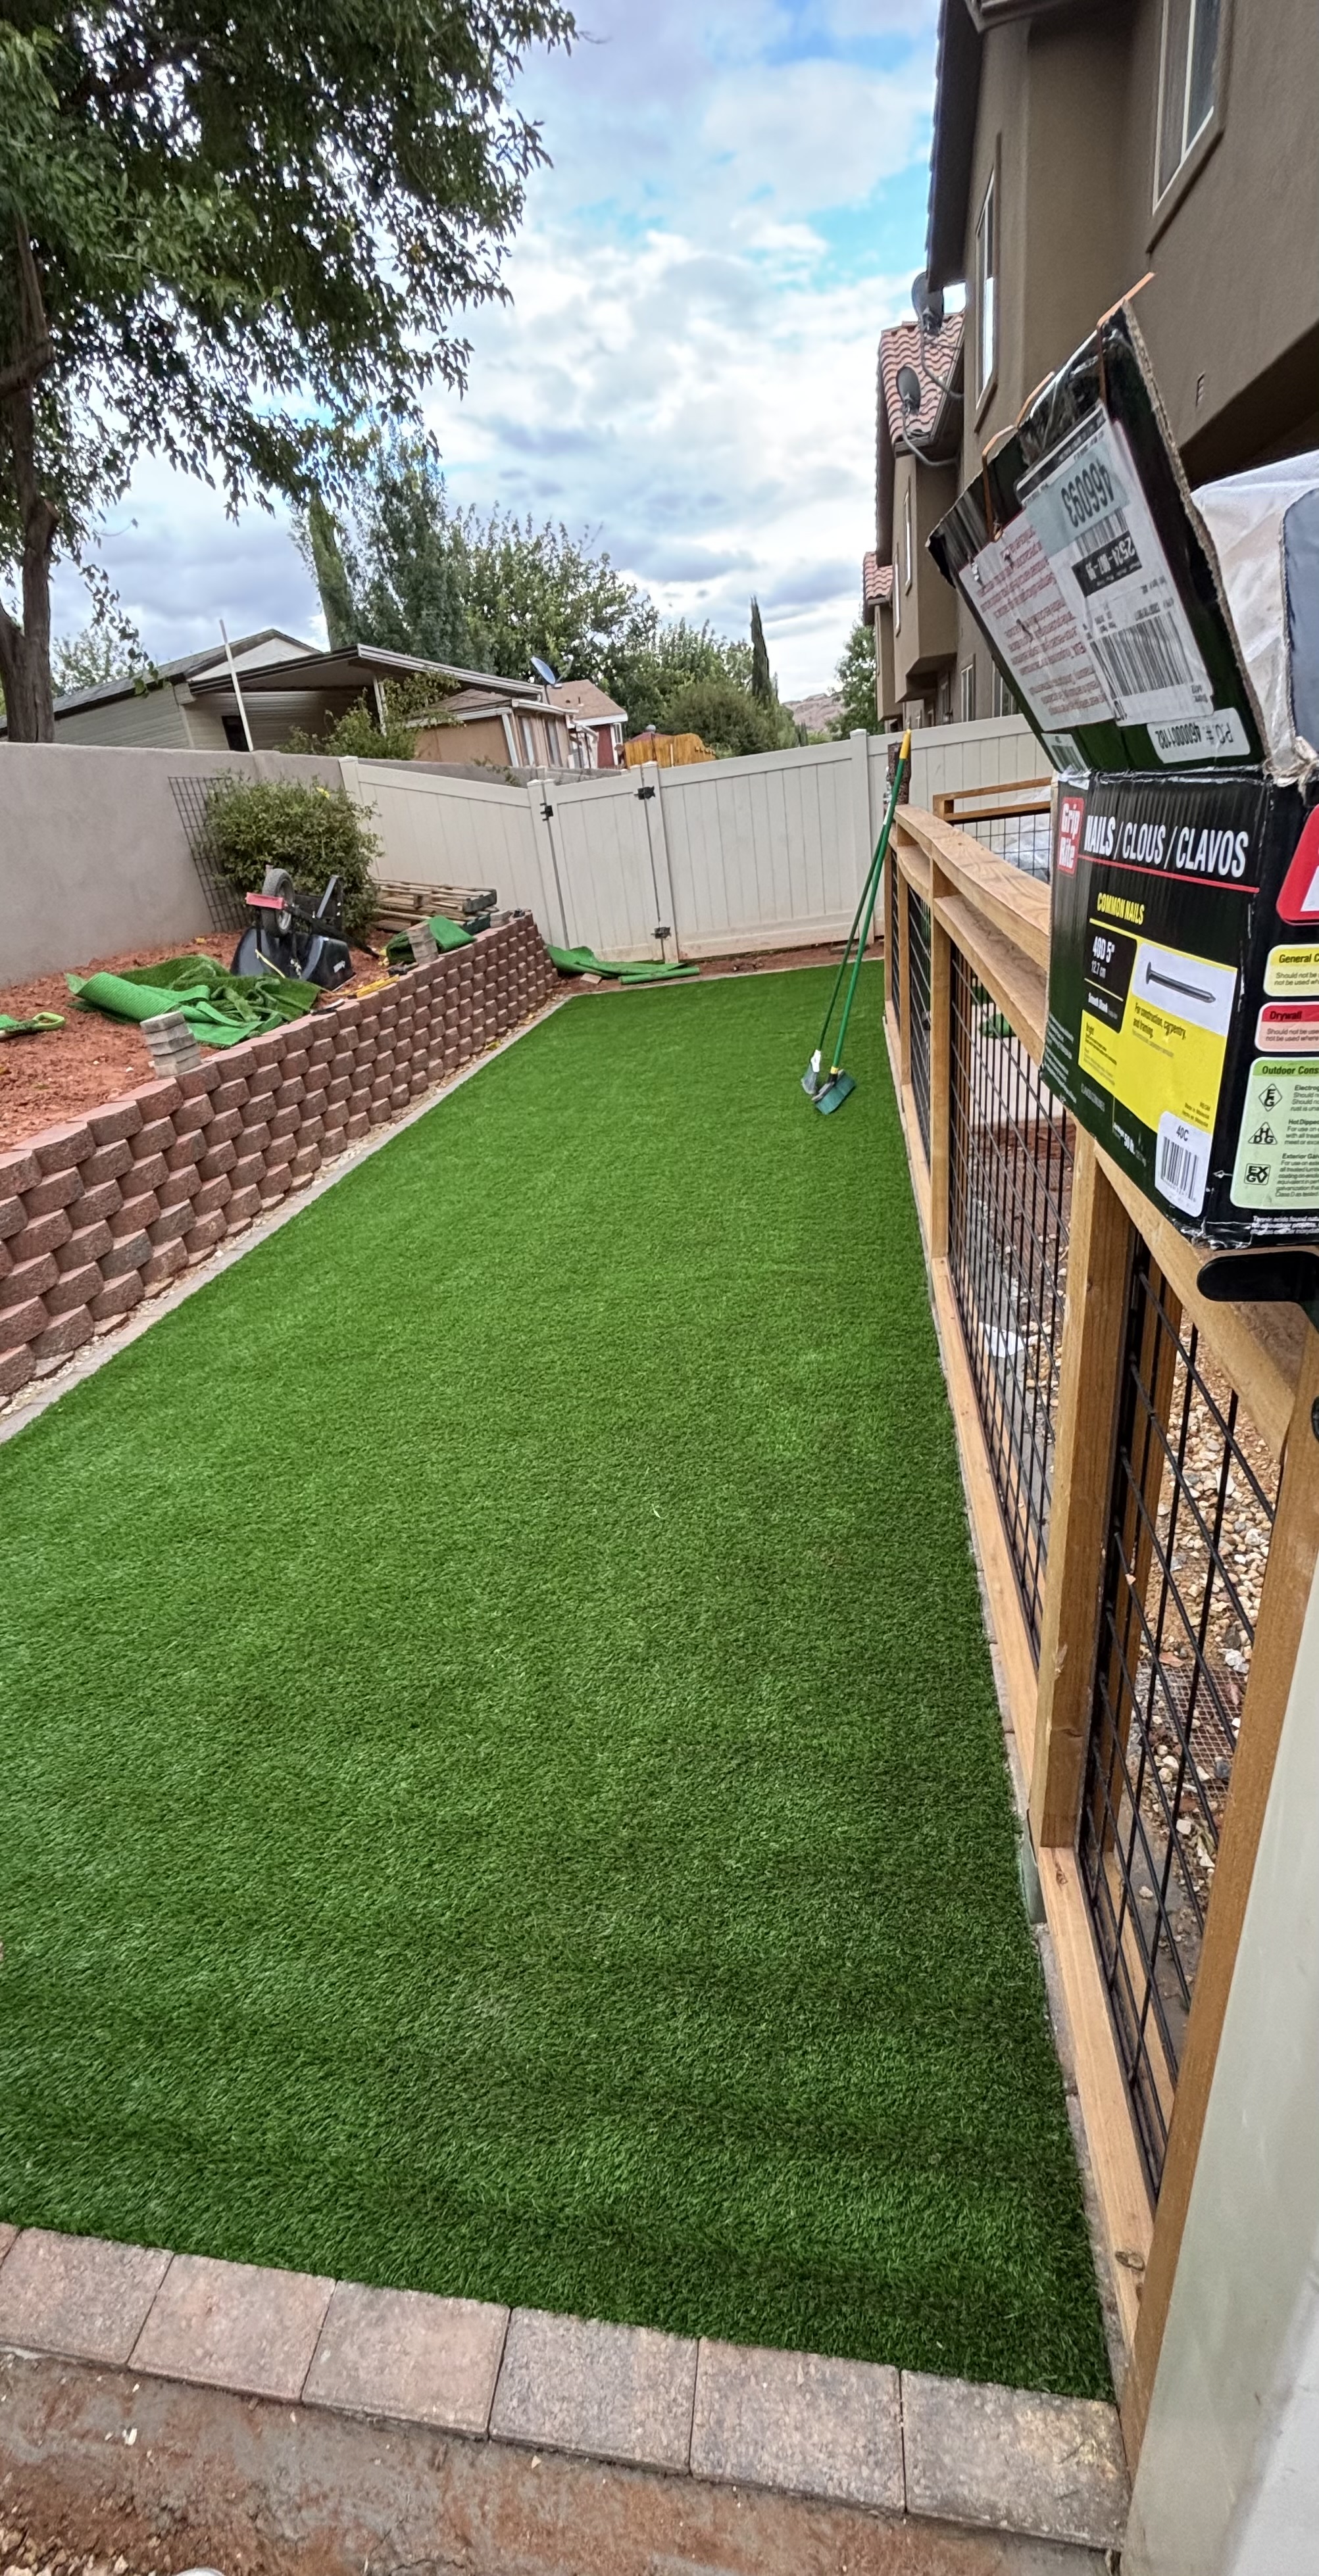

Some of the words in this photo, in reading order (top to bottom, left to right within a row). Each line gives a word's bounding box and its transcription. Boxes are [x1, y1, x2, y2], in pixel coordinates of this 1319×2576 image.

[1061, 461, 1114, 528] 466093
[1060, 803, 1080, 838] Grip
[1059, 837, 1076, 869] Rite
[1084, 815, 1116, 856] NAILS
[1123, 822, 1166, 865] CLOUS
[1176, 827, 1249, 878] CLAVOS
[1097, 892, 1126, 918] COMMON
[1124, 900, 1145, 925] NAILS
[1093, 936, 1107, 960] 40D
[1279, 954, 1312, 963] General
[1270, 1011, 1303, 1021] Drywall
[1262, 1066, 1295, 1075] Outdoor
[1176, 1125, 1189, 1142] 40C
